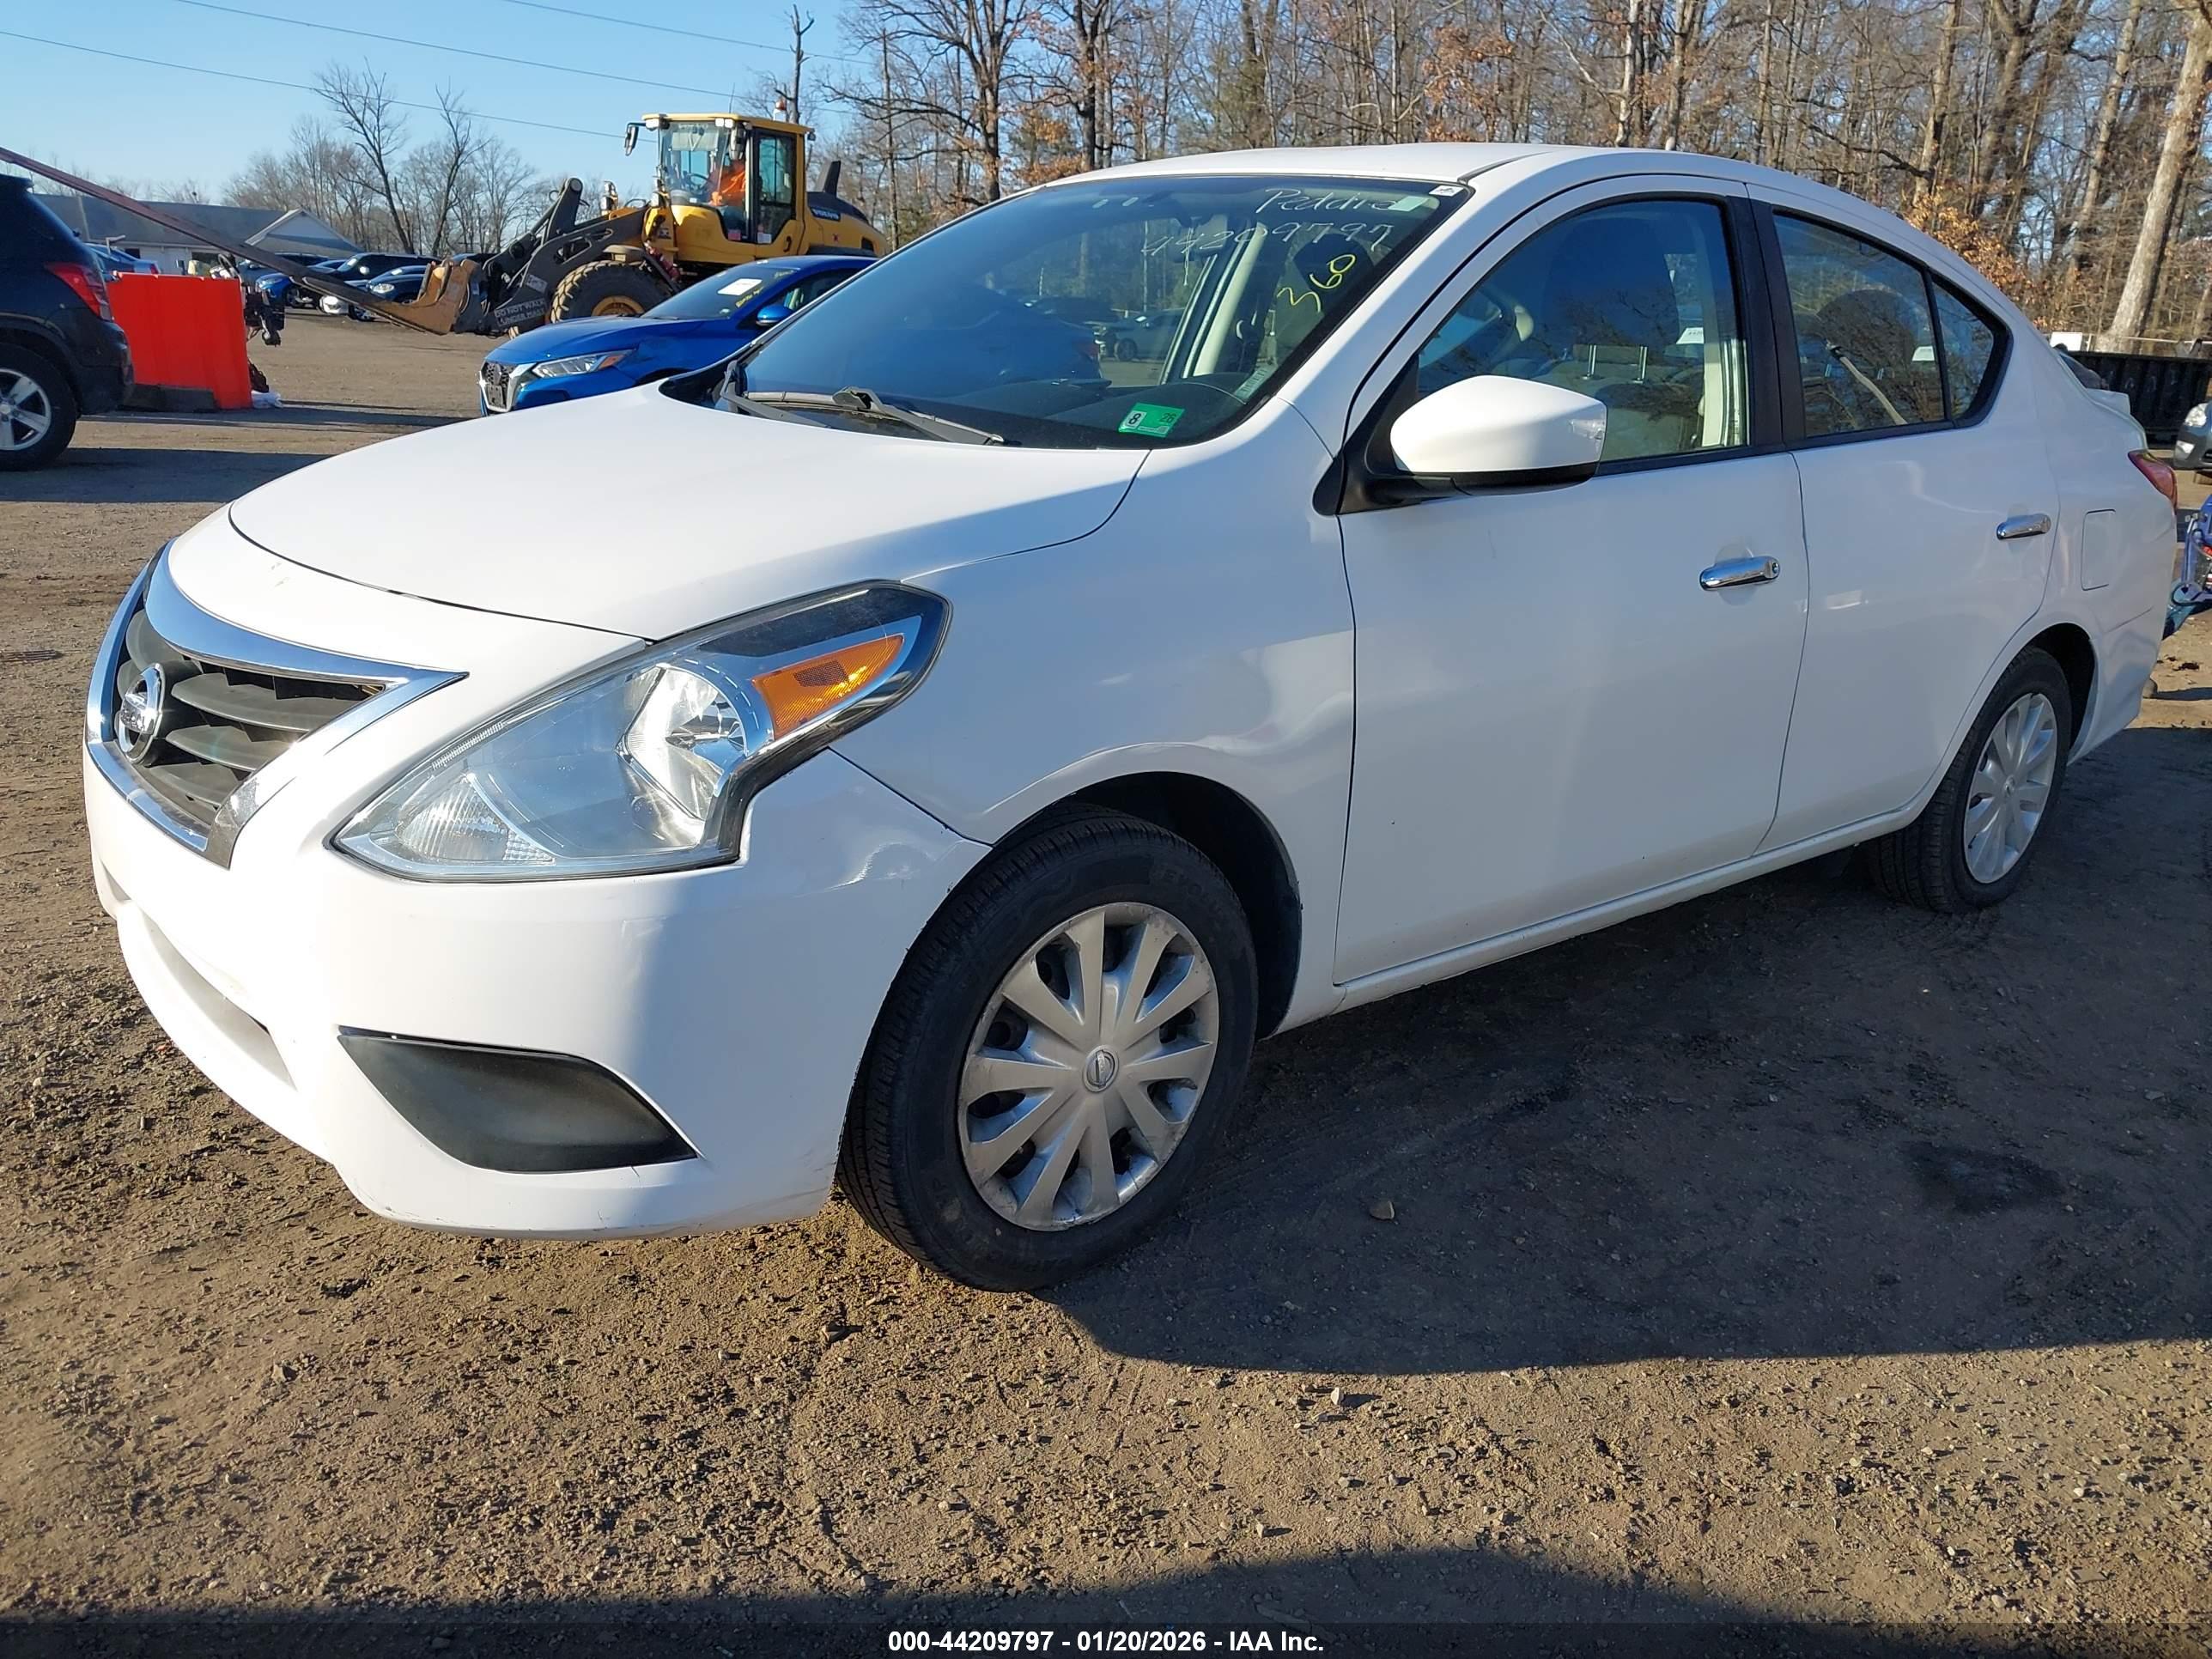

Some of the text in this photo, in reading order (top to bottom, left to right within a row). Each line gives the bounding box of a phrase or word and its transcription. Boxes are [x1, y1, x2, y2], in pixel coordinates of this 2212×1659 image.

[1141, 222, 1395, 257] 44209797
[1276, 254, 1356, 313] 360
[1129, 412, 1176, 425] 8 26
